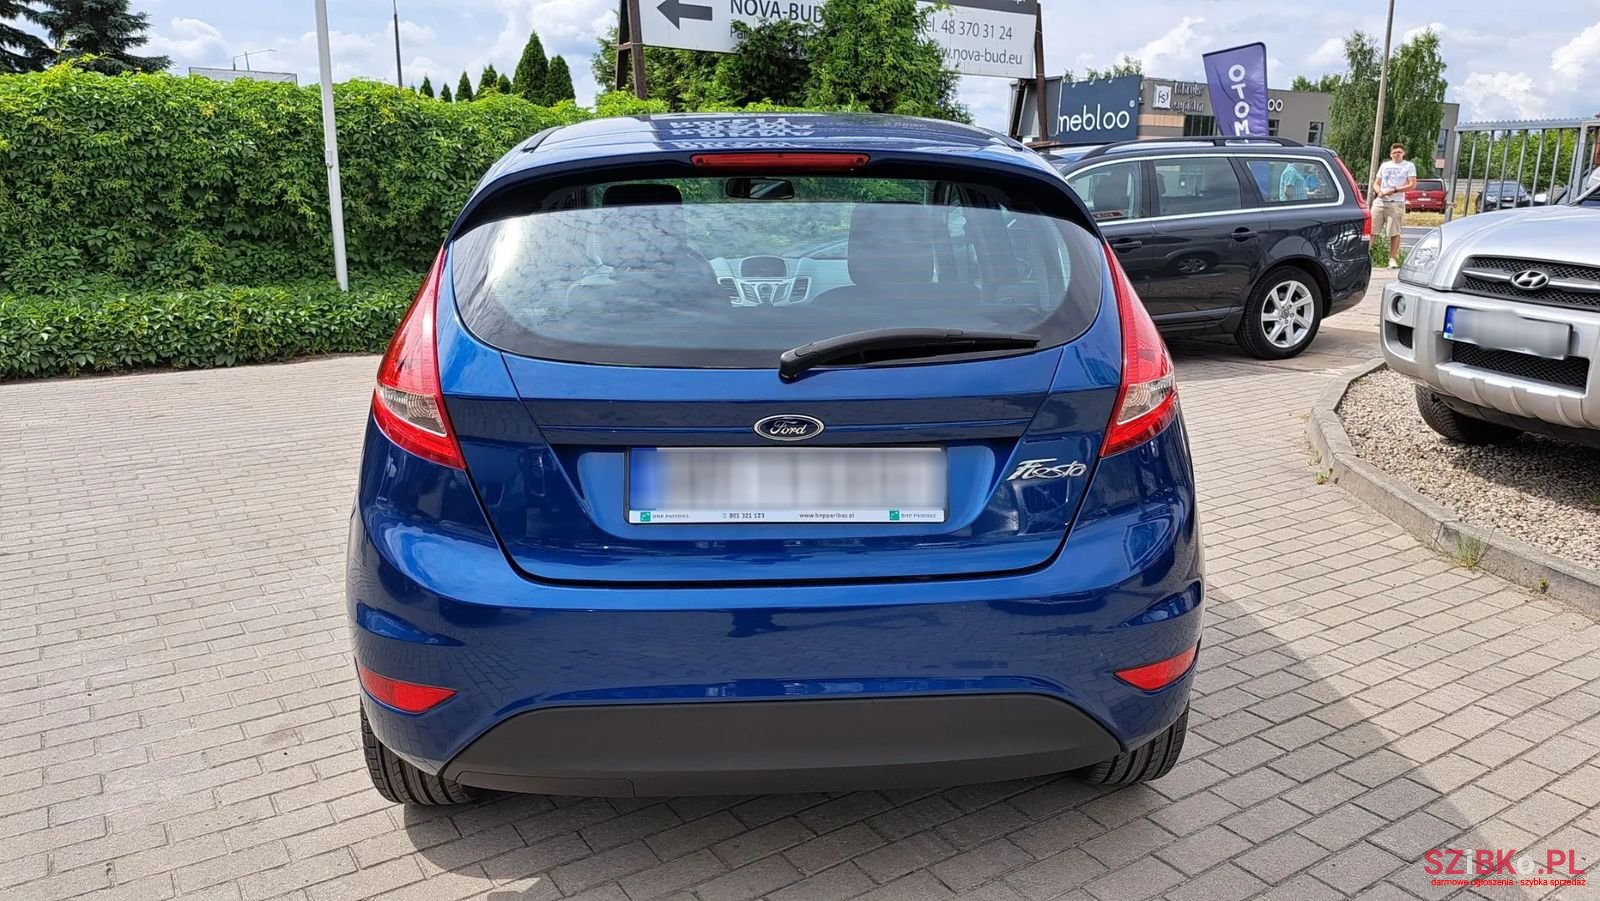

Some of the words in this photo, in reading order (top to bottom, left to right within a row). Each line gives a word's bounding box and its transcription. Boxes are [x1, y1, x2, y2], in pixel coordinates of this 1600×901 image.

[730, 0, 825, 23] NOVA-BUD
[921, 17, 937, 33] el.
[941, 20, 955, 35] 48
[958, 20, 979, 37] 370
[982, 23, 994, 39] 31
[999, 25, 1013, 40] 24
[769, 419, 808, 435] Ford
[1006, 458, 1087, 481] Fiesta
